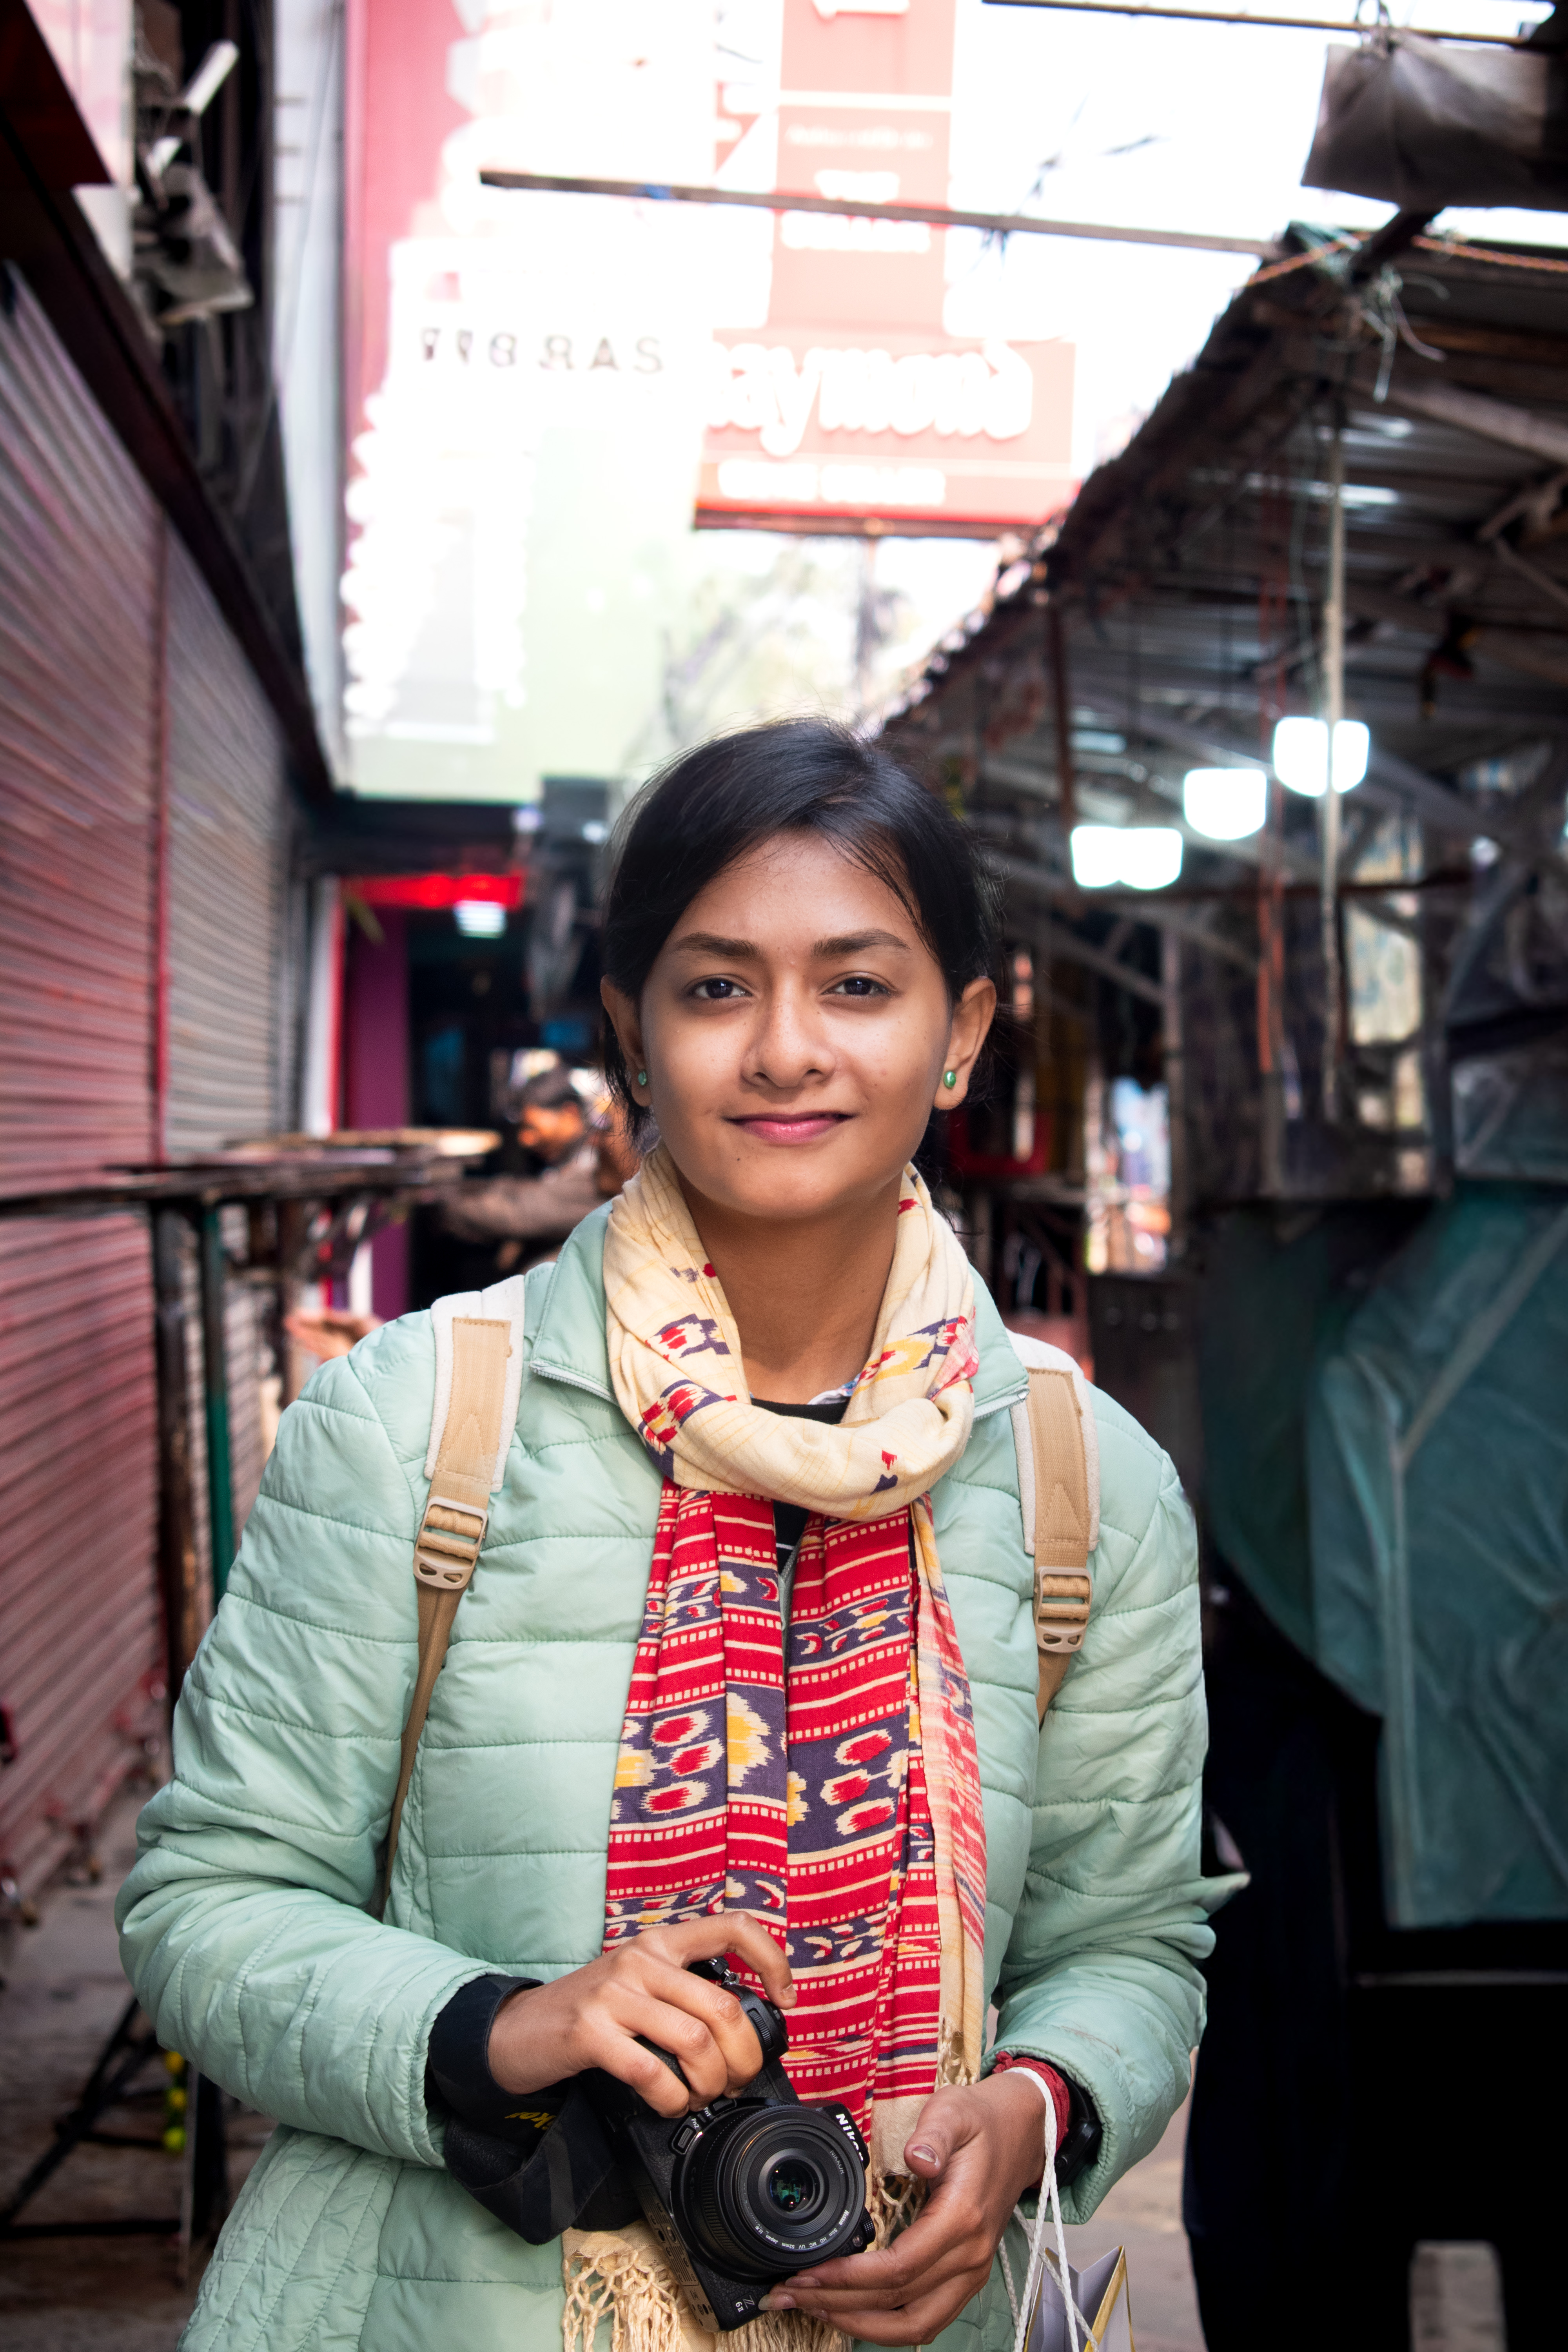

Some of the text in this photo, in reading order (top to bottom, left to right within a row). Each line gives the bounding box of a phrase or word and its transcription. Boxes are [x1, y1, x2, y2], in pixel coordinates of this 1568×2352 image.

[691, 2118, 699, 2129] Fn2
[828, 2228, 838, 2236] Slim
[765, 2234, 778, 2244] Japan
[742, 2295, 755, 2309] Z
